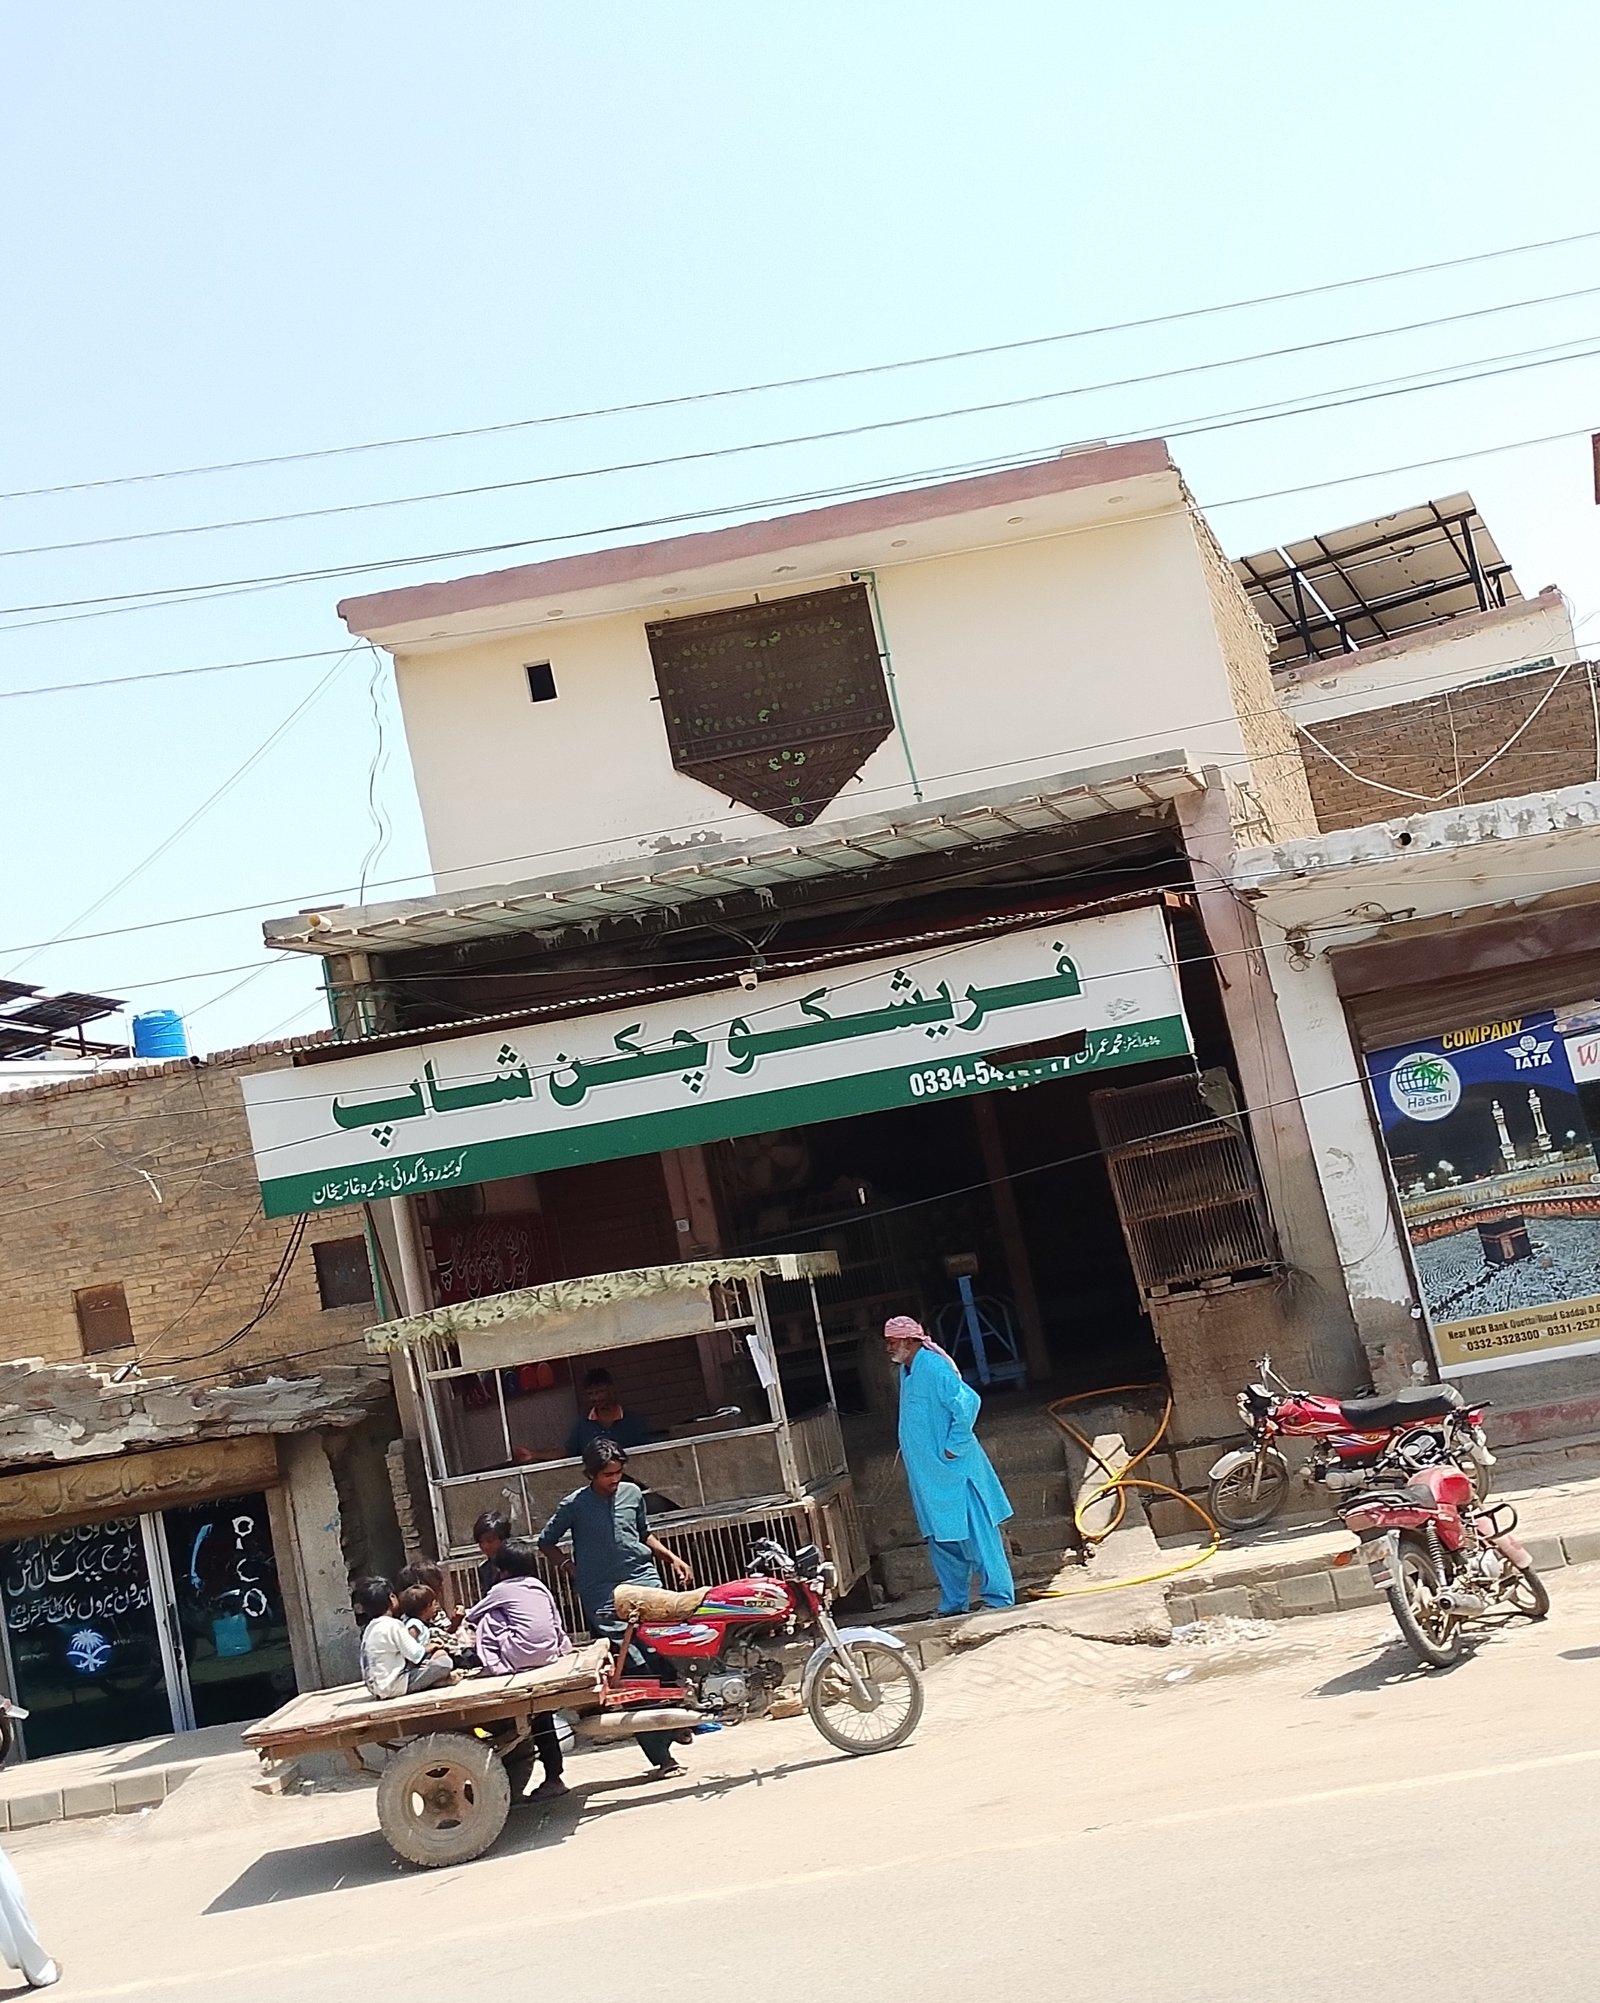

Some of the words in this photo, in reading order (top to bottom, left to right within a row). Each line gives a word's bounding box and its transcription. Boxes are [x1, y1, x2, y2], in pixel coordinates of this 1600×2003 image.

[1441, 1018, 1522, 1050] COMPANY
[549, 1022, 708, 1107] چکن
[1515, 1053, 1553, 1071] IATA
[332, 1043, 533, 1148] شاپ
[1407, 1089, 1451, 1109] Hassni
[360, 1172, 384, 1198] ڈیرہ
[420, 1166, 443, 1184] روڈ
[1448, 1330, 1467, 1340] Near
[1468, 1325, 1487, 1337] MCB
[1488, 1321, 1509, 1333] Bank
[1467, 1329, 1540, 1352] 0332-3328300
